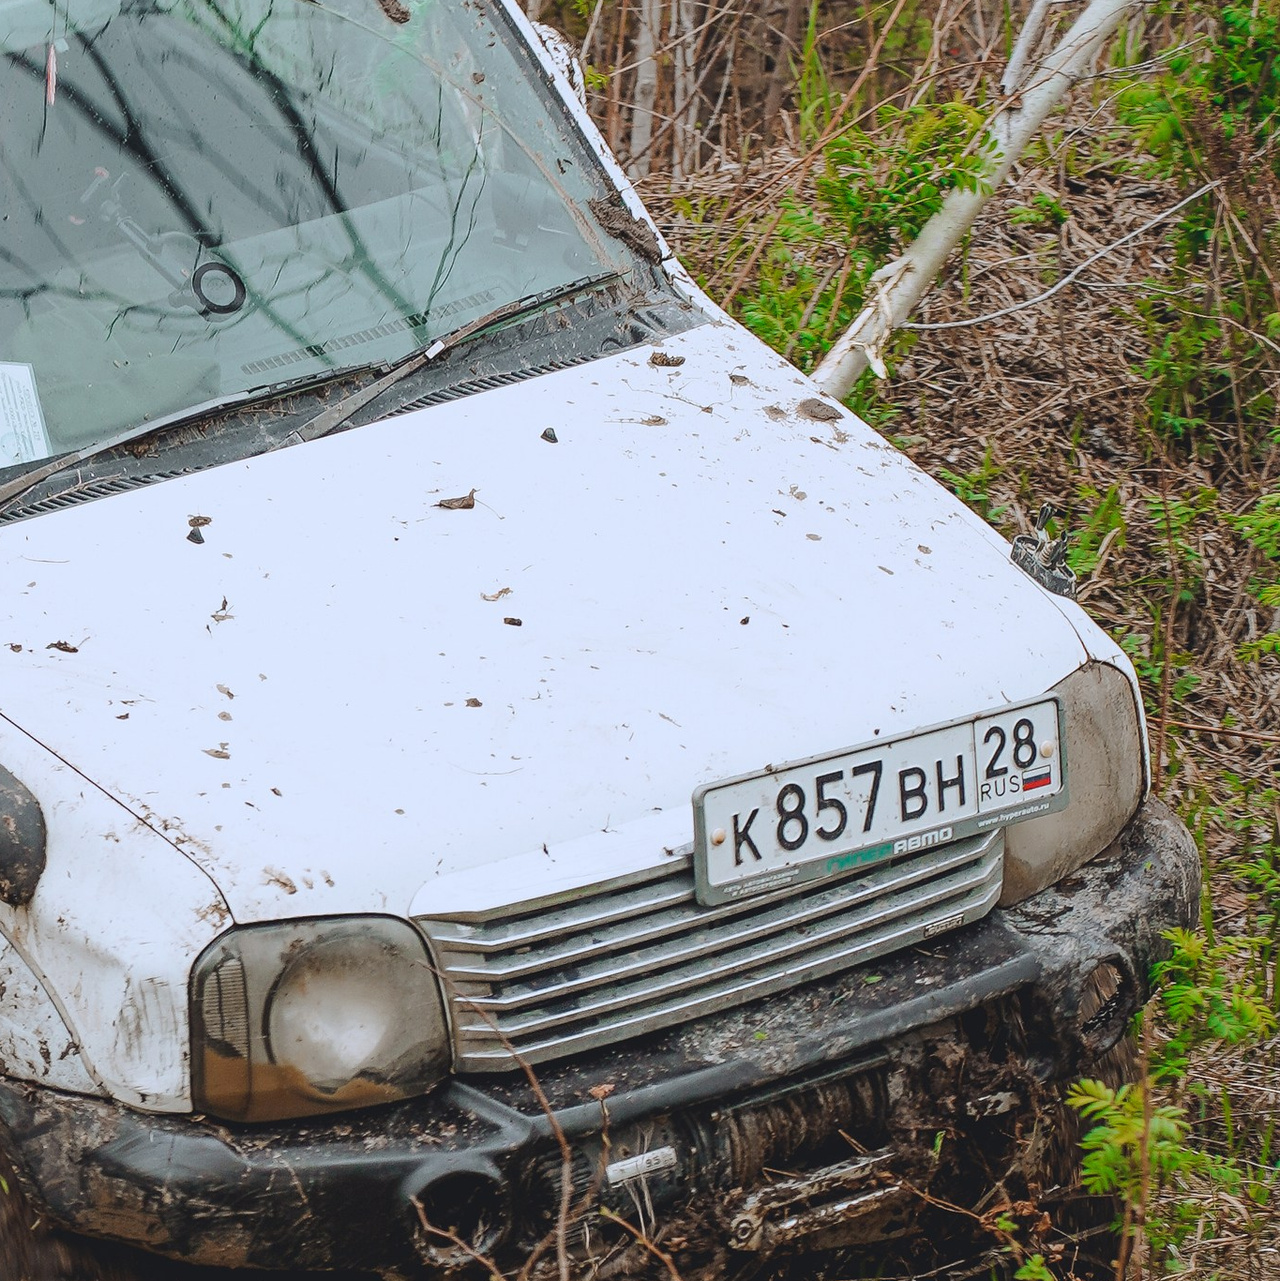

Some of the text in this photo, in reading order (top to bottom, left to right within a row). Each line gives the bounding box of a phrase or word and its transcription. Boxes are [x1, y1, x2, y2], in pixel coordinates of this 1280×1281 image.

[983, 718, 1037, 780] 28
[980, 774, 1020, 803] RUS
[977, 802, 1050, 828] www.hyperauto.ru
